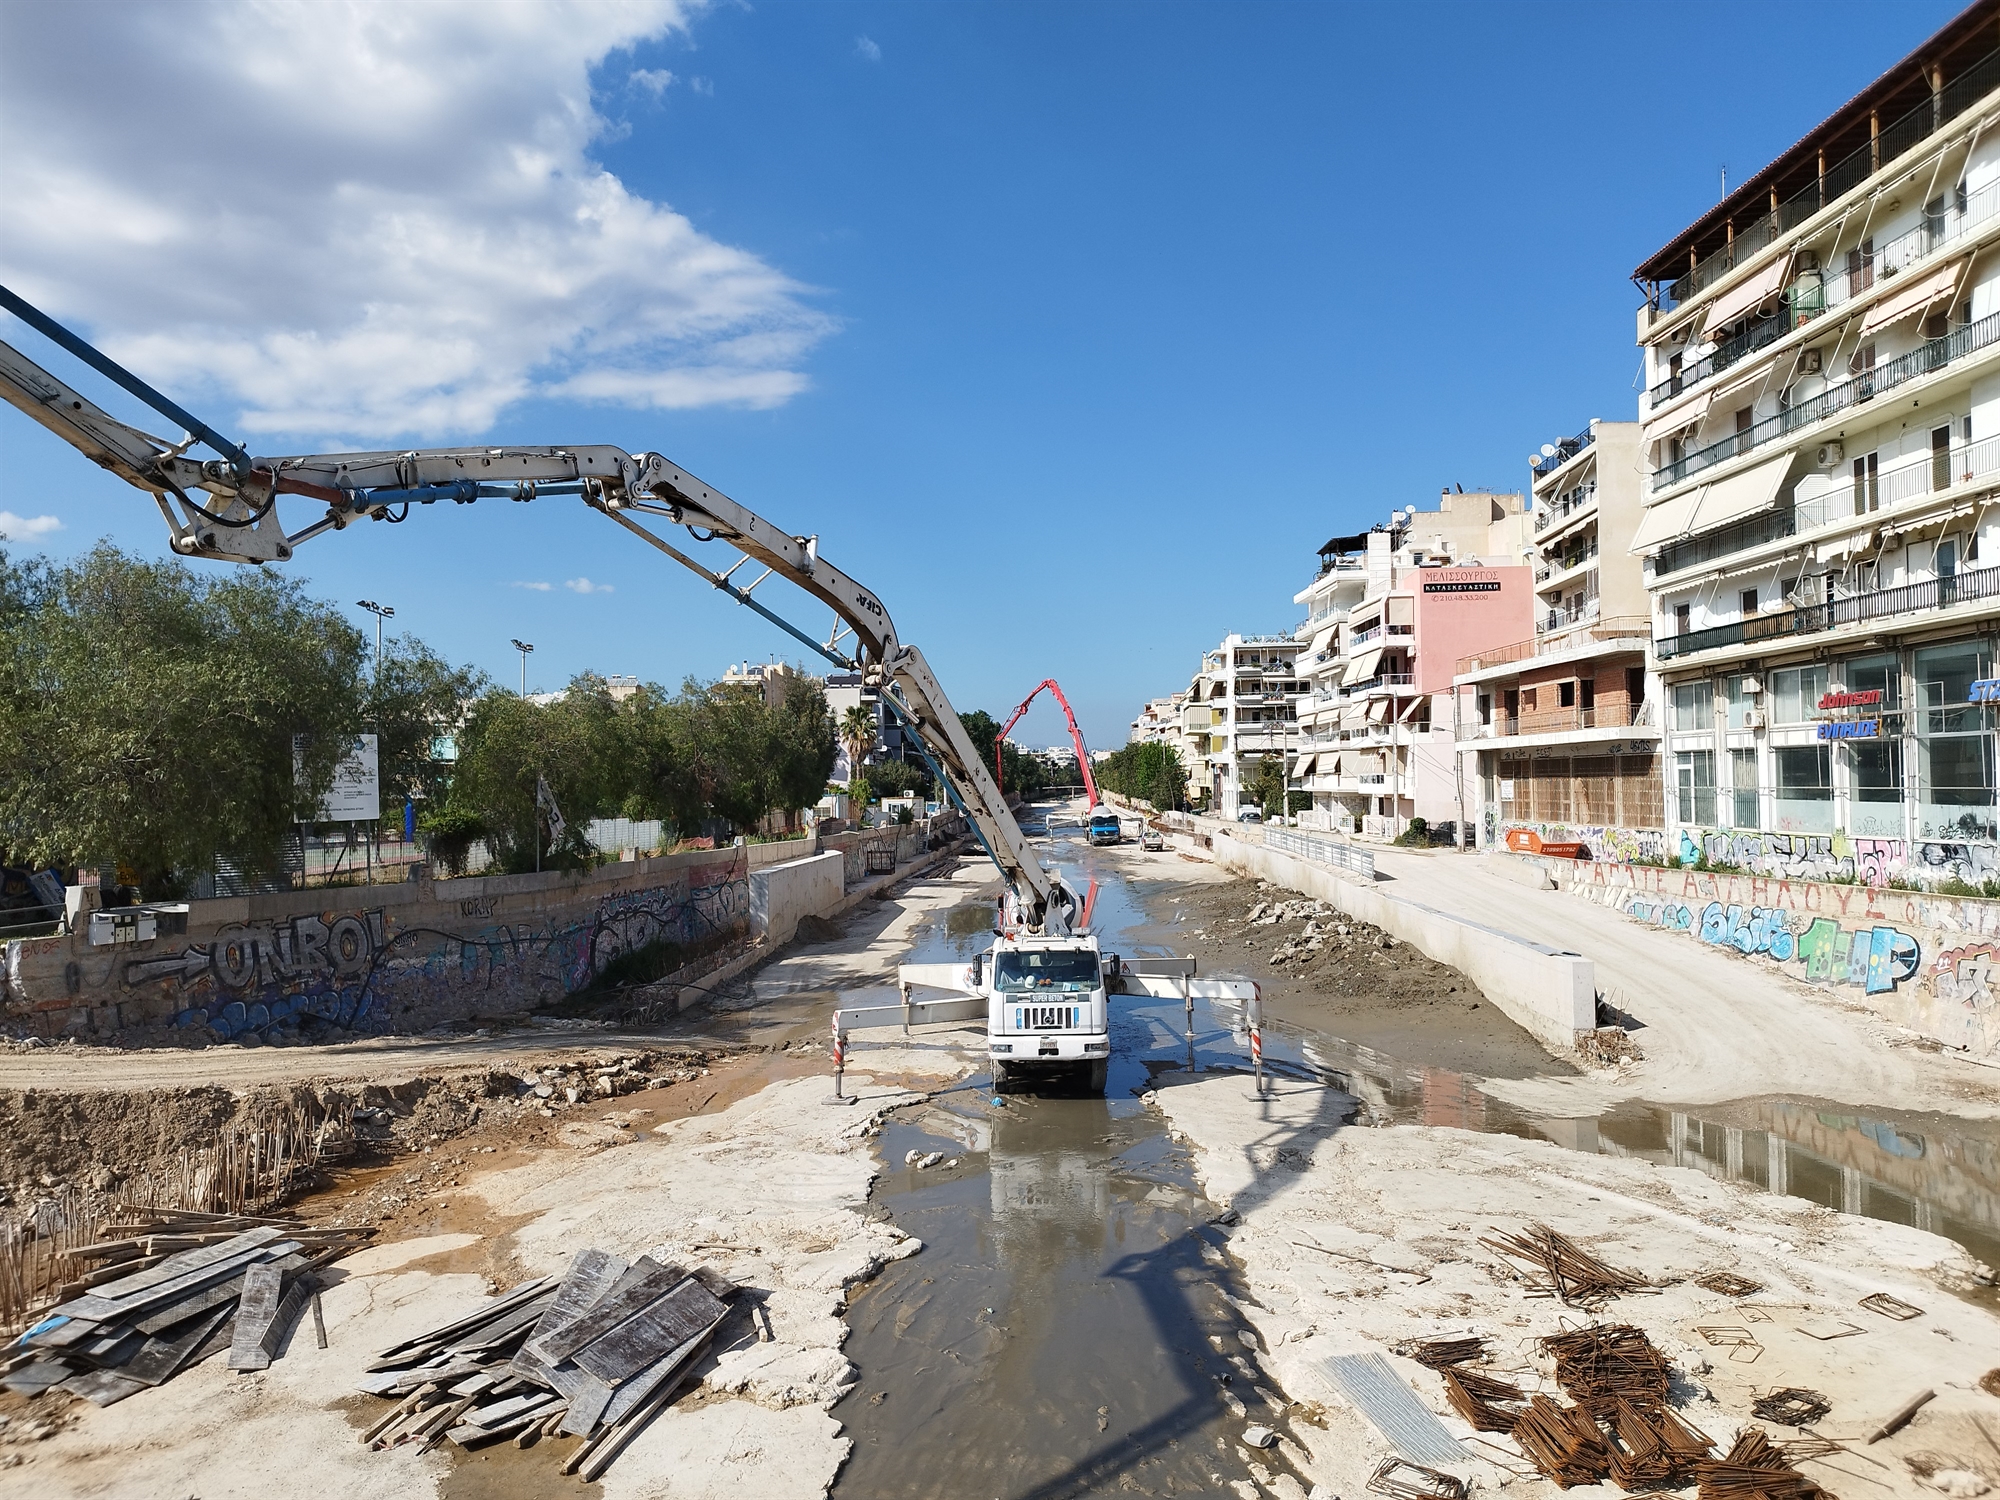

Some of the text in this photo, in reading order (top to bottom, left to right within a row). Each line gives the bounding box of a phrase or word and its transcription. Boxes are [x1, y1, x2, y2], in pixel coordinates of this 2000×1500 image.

[1425, 570, 1498, 582] ΜΕΛΙΣΣΟΥΡΓΟΣ
[1818, 689, 1881, 709] Johnson
[1817, 719, 1879, 739] EVINRUDE
[1573, 860, 1667, 893] ΑΠΑΤΕ
[1032, 994, 1048, 1002] SUPER
